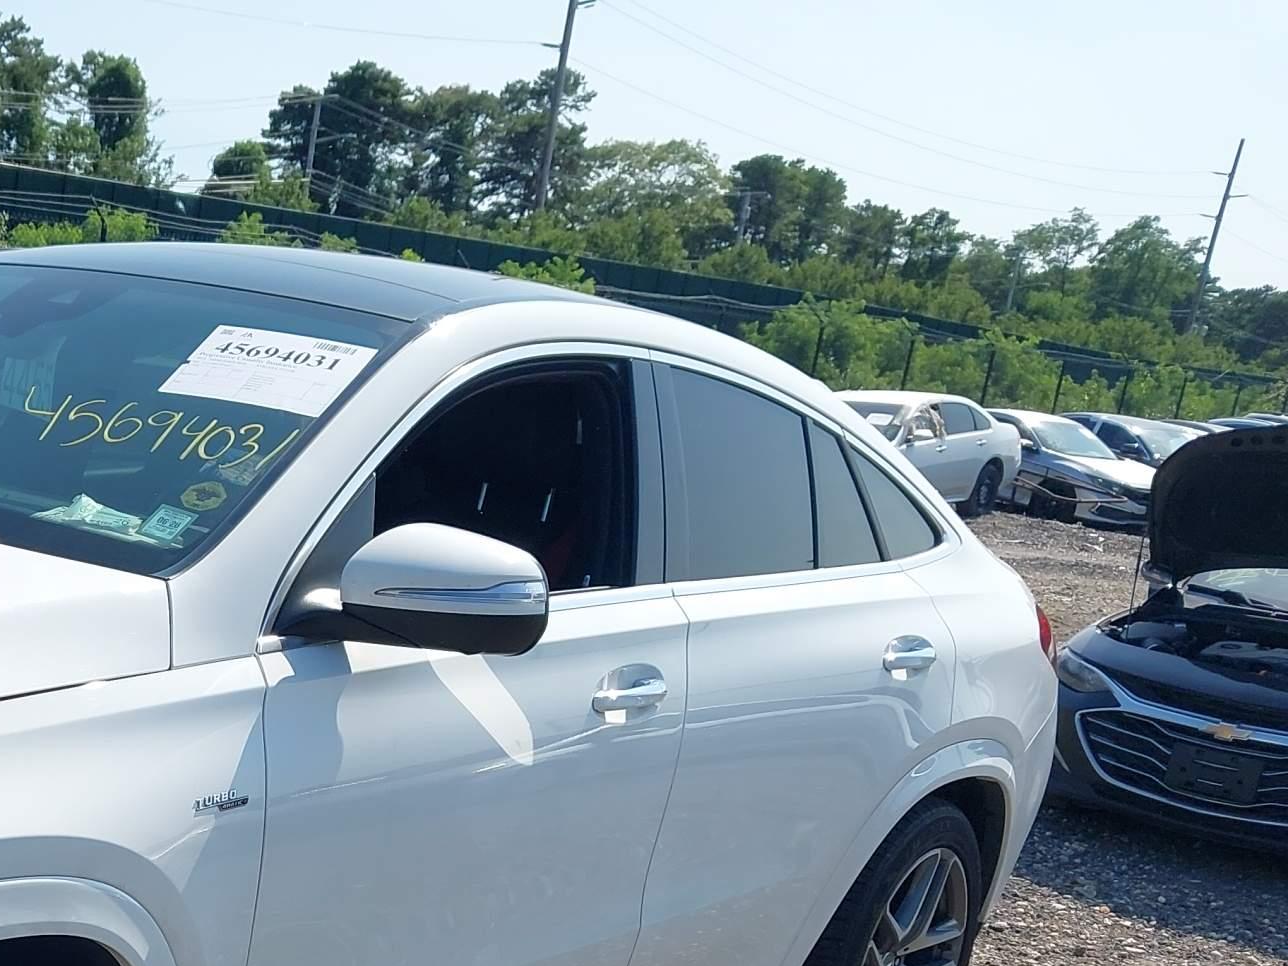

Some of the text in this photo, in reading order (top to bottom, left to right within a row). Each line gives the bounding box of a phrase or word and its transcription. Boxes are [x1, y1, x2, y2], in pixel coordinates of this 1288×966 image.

[215, 341, 342, 370] 45694031
[24, 385, 300, 471] 45694031
[193, 789, 237, 810] TURBO
